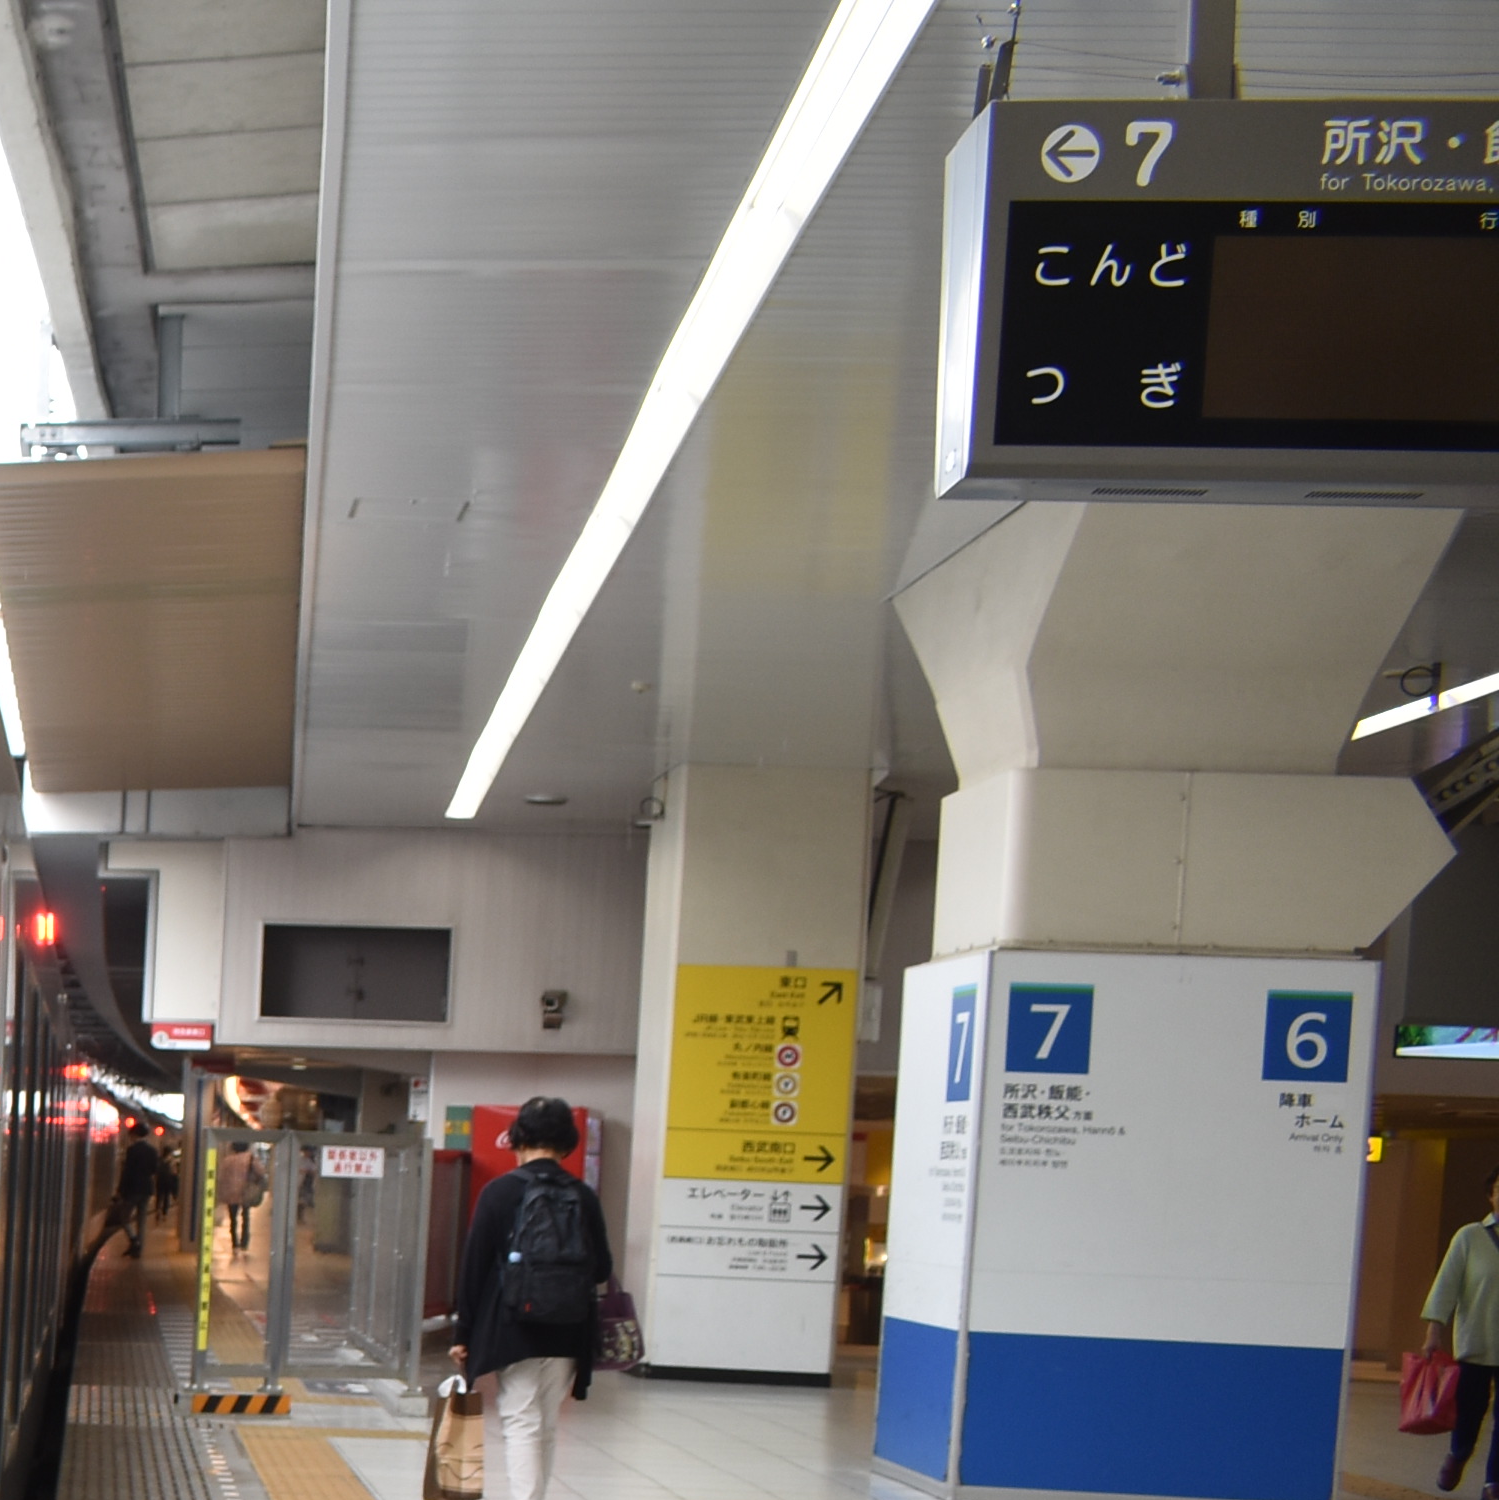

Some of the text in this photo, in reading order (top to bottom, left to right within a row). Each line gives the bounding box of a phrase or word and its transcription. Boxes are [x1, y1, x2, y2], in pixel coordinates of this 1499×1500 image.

[1125, 121, 1173, 187] 7
[1320, 172, 1494, 194] for Tokorozawa,
[1035, 244, 1186, 287] こんど
[780, 976, 807, 988] 東口
[1030, 1004, 1071, 1060] 7
[1286, 1011, 1328, 1069] 6
[954, 1011, 971, 1084] 7
[1279, 1093, 1312, 1107] 降車
[1295, 1114, 1344, 1129] ホーム
[1289, 1132, 1344, 1144] Arrival Only
[742, 1141, 796, 1154] 西武南口
[687, 1187, 765, 1200] エレベーター
